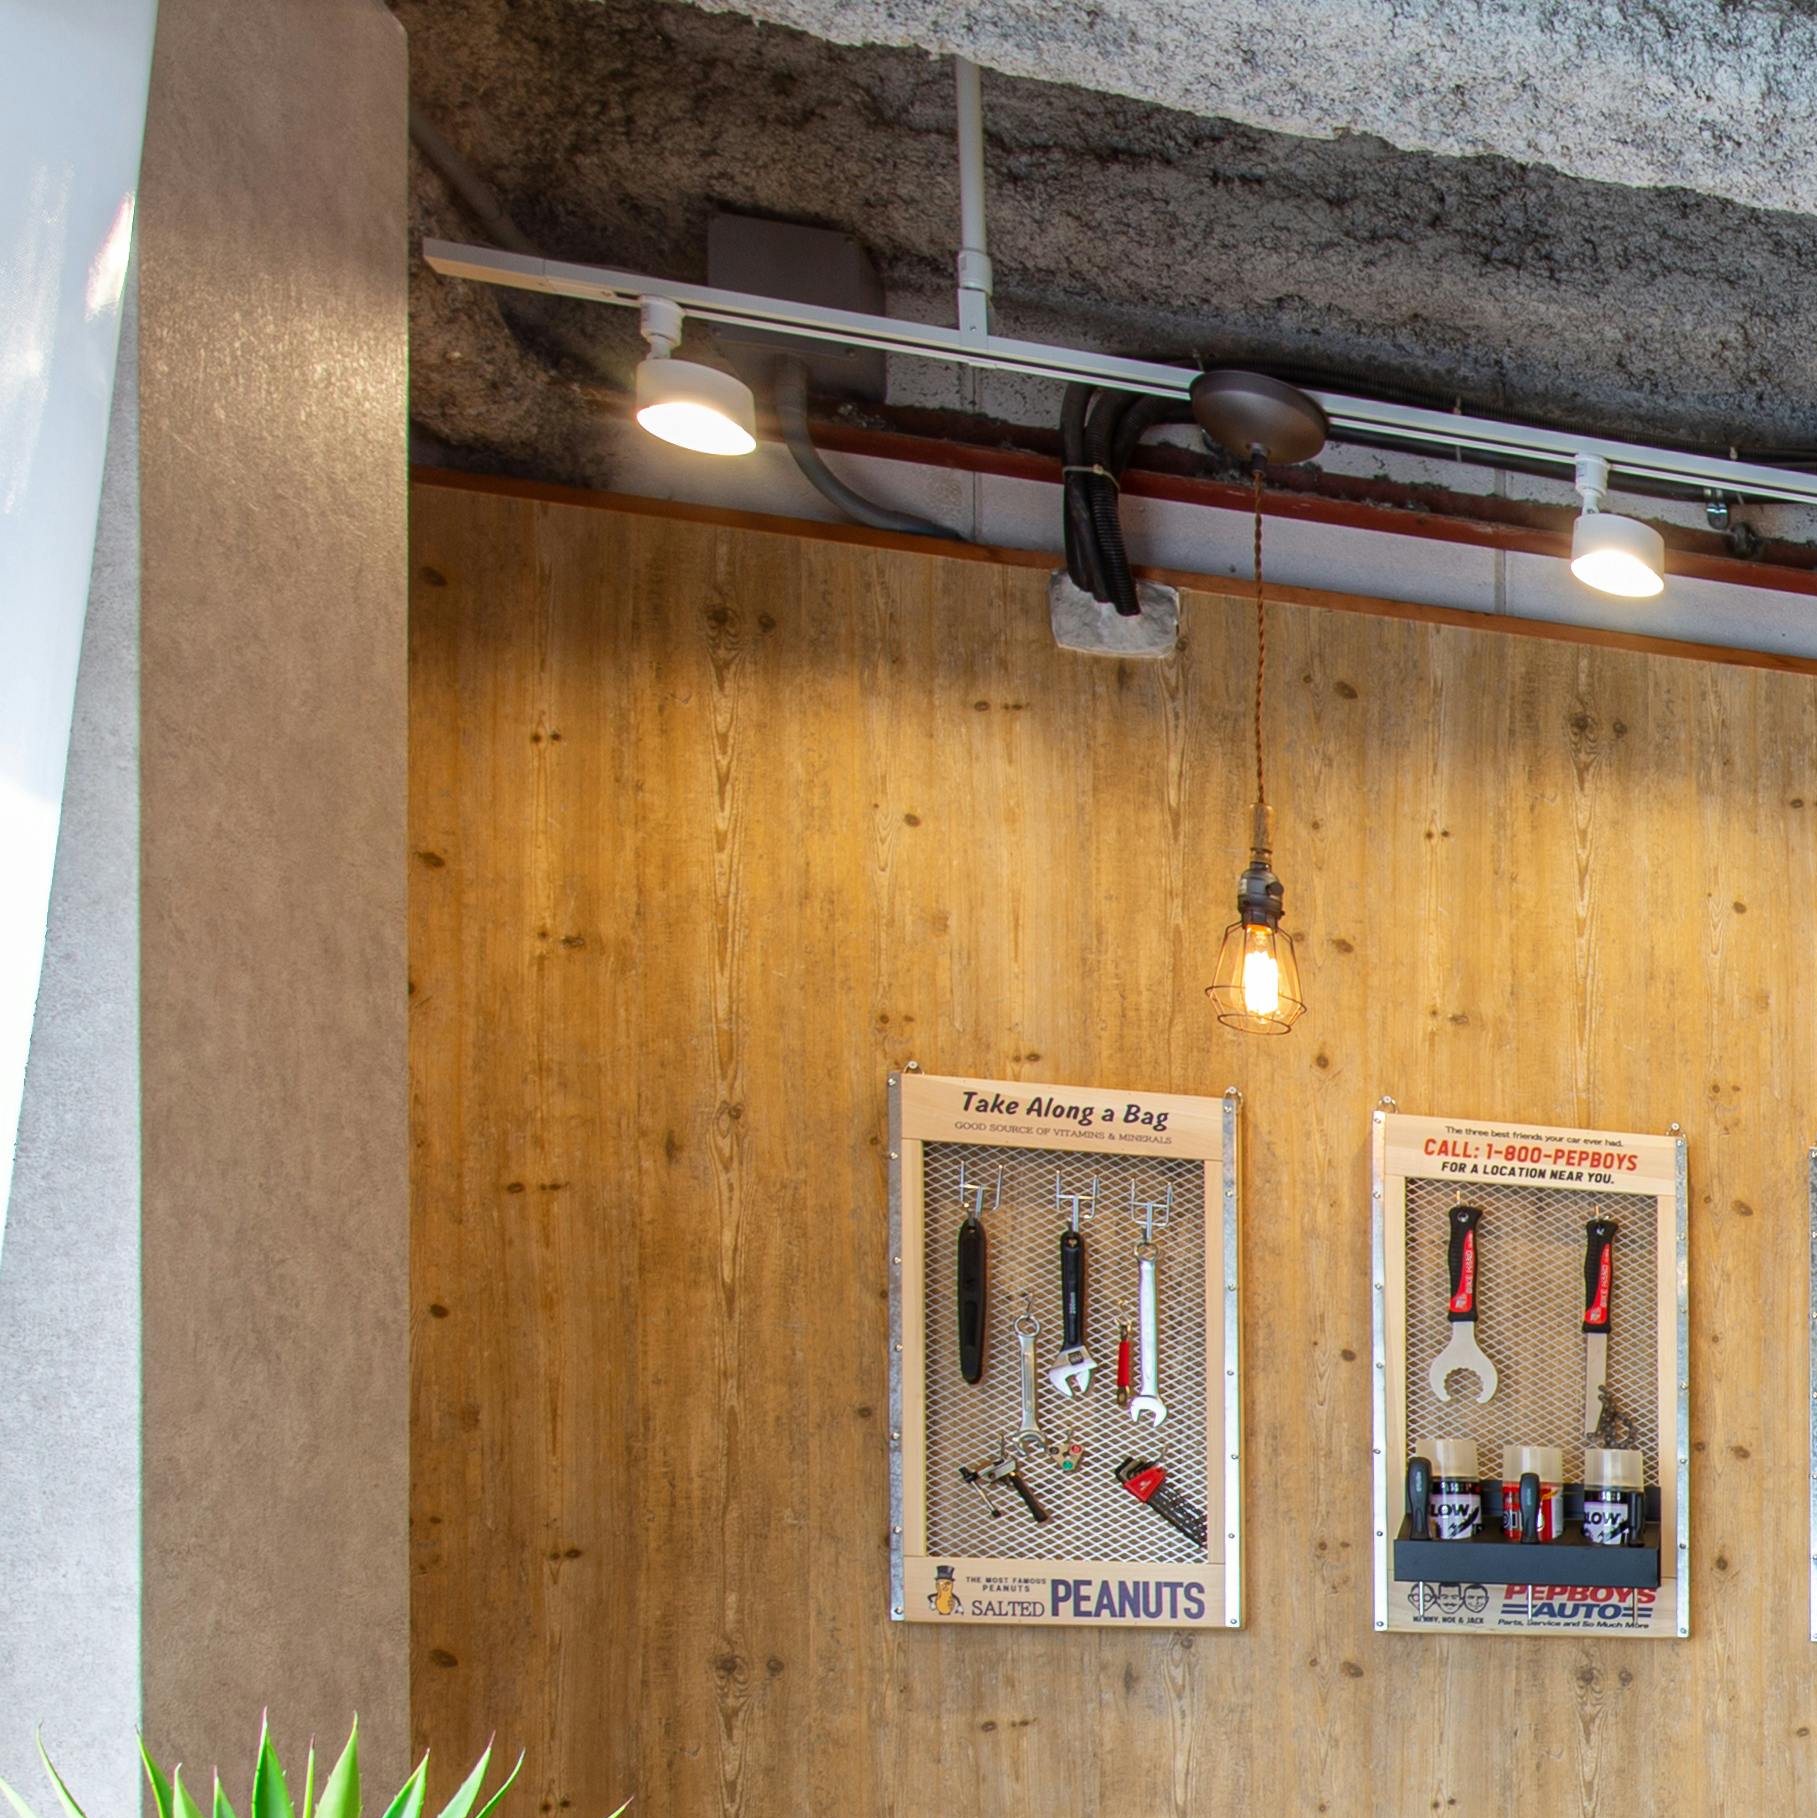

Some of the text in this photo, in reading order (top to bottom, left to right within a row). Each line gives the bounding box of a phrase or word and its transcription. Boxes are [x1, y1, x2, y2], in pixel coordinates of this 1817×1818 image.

[963, 1091, 1169, 1131] Take Along a Bag
[954, 1120, 1172, 1145] GOOD SOURCE OF VITAMINS & MINERALS
[1445, 1125, 1623, 1147] The three best friends your car ever had.
[1424, 1138, 1638, 1171] CALL: 1-800-PEPBOYS
[1441, 1161, 1615, 1184] FOR A LOCATION NEAR YOU.
[1430, 1503, 1469, 1517] LOW
[966, 1576, 1047, 1585] THE MOST FAMOUS
[971, 1579, 1206, 1620] SALTED PEANUTS
[1504, 1584, 1657, 1603] PEPBOYS
[1413, 1616, 1440, 1624] MNNY,
[1531, 1602, 1622, 1619] AUTO
[1498, 1618, 1523, 1626] Parts,
[1527, 1619, 1560, 1627] Service
[1625, 1621, 1649, 1629] More
